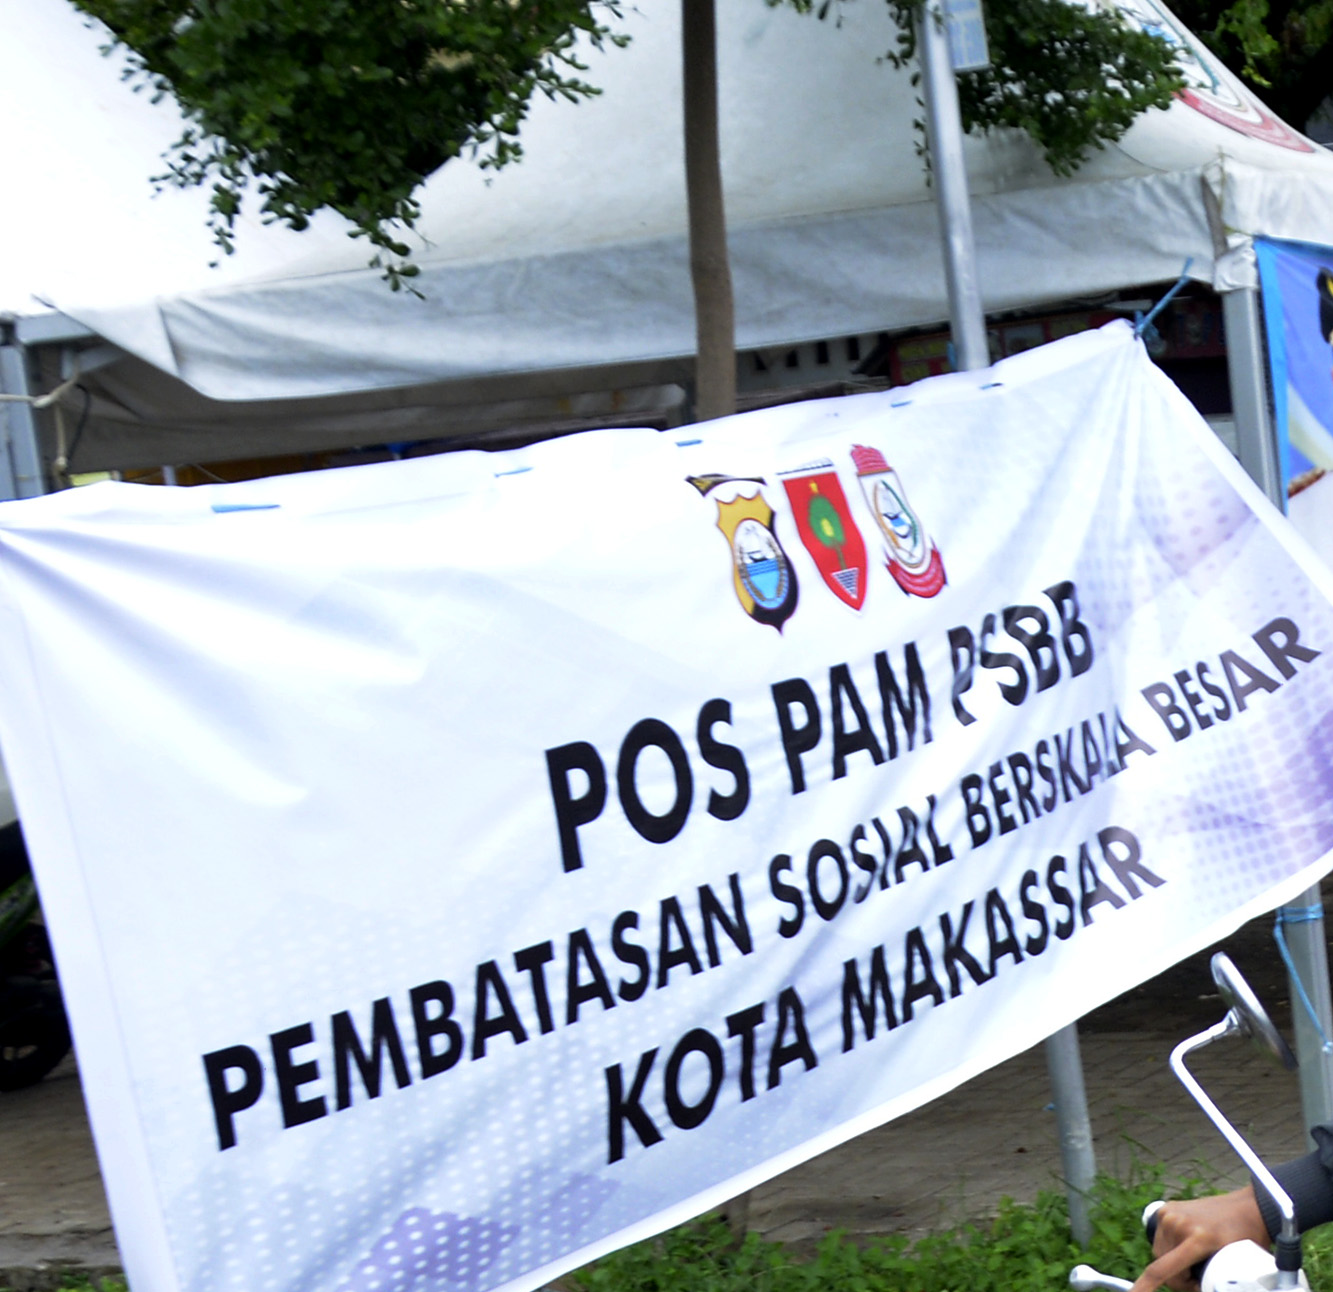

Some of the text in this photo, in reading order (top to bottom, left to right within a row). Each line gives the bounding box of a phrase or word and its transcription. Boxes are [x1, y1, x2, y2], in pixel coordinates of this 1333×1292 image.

[202, 616, 1322, 1152] PEMBATASAN SOSIAL BERSKALA BESAR
[544, 579, 1095, 873] POS PAM PSBB
[605, 825, 1168, 1165] KOTA MAKASSAR
